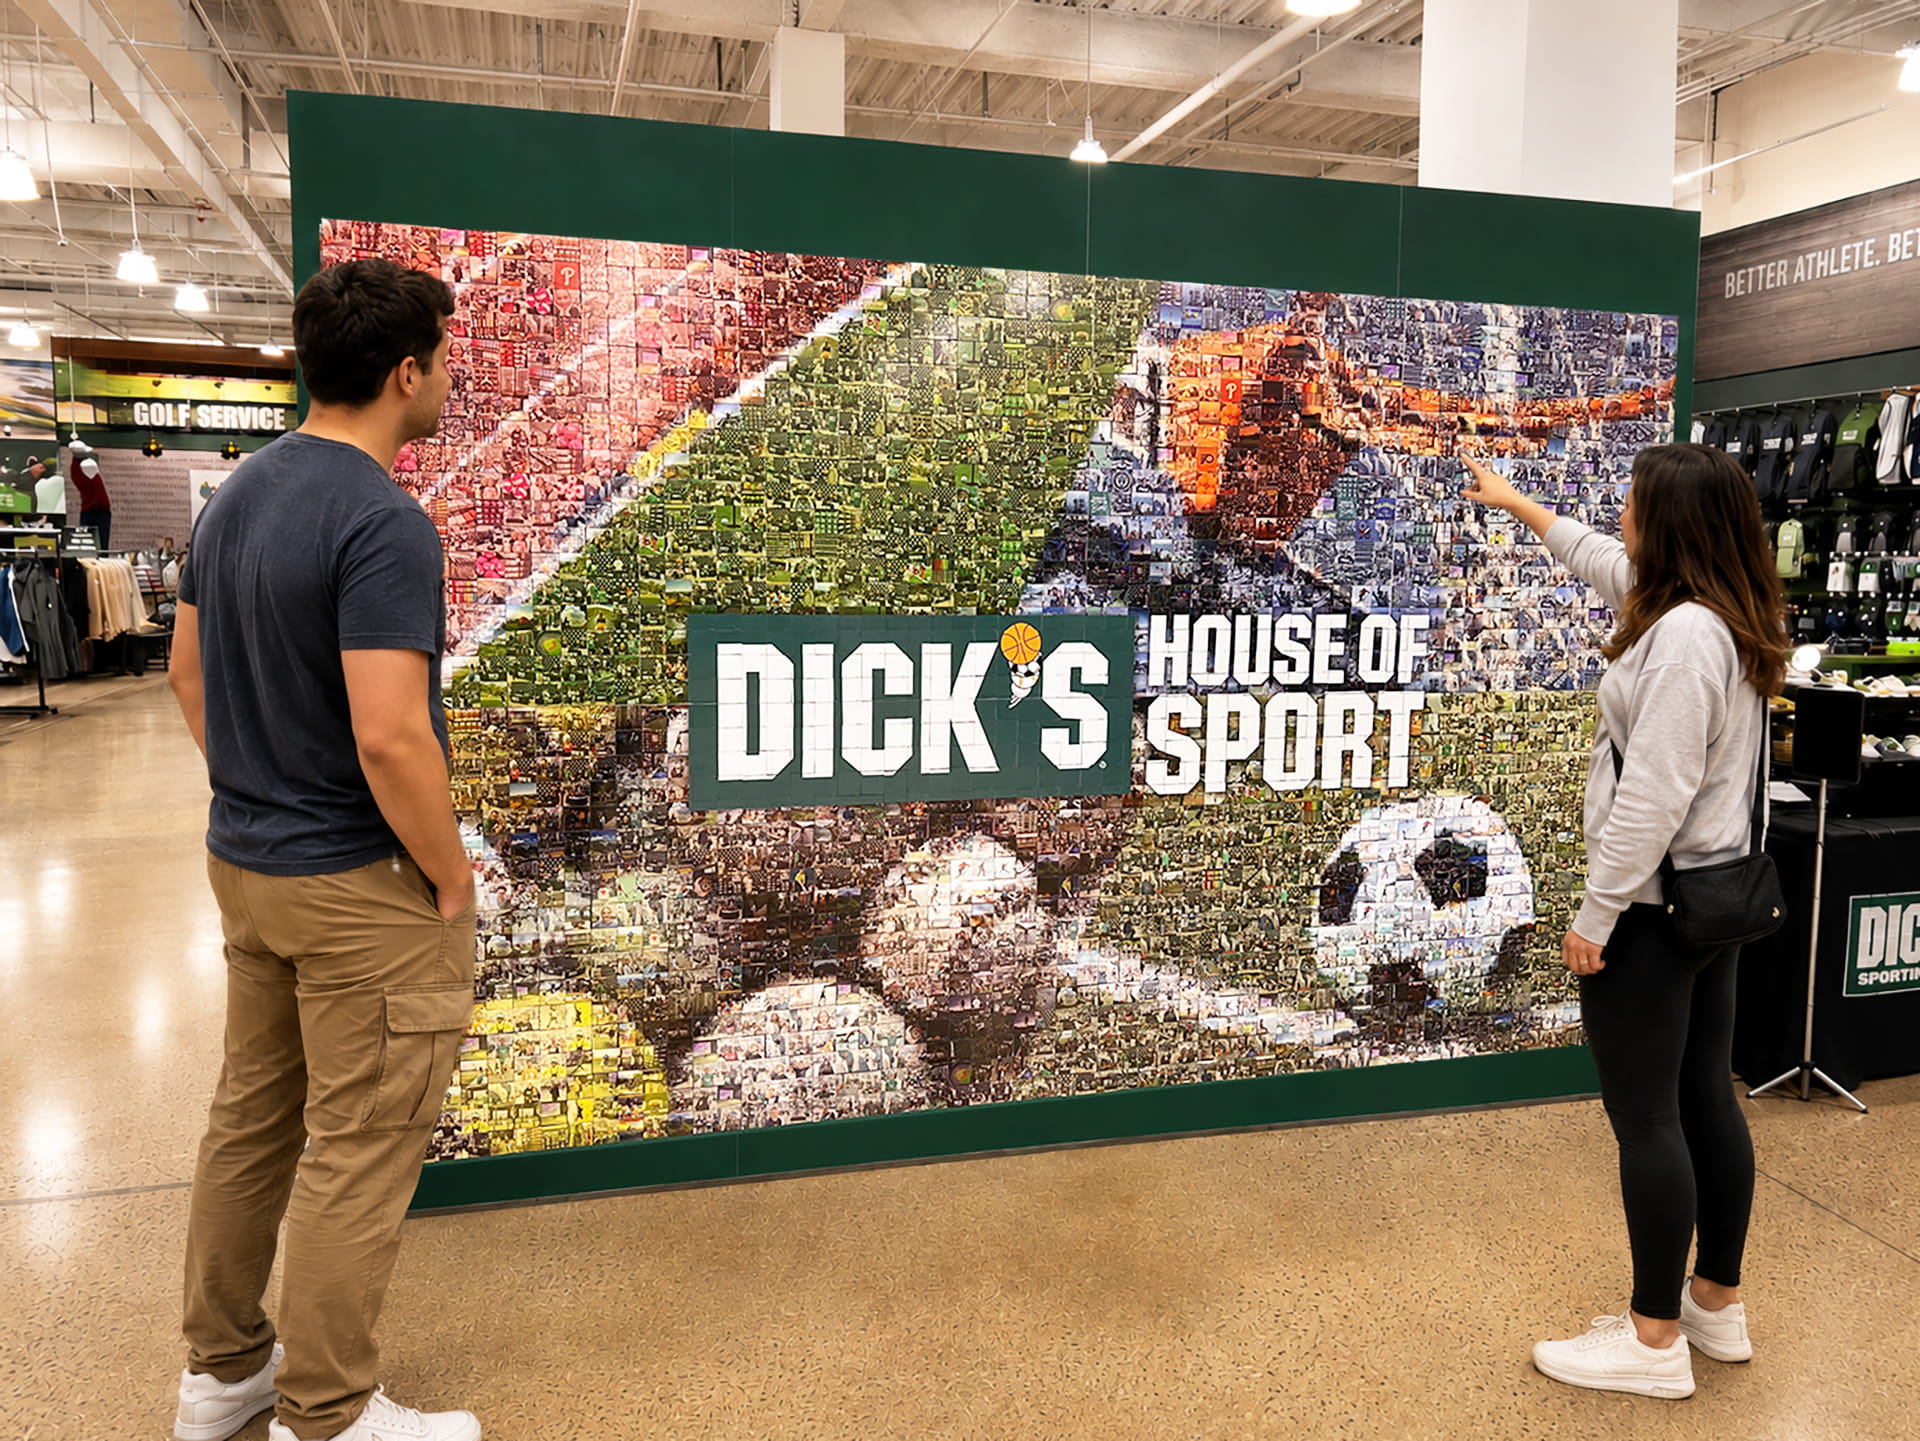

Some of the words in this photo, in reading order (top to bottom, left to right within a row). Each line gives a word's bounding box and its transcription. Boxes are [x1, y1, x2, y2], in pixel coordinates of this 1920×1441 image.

[1724, 259, 1788, 299] BETTER
[1793, 238, 1881, 285] ATHLETE.
[133, 401, 191, 428] GOLF
[196, 404, 286, 431] SERVICE
[1148, 613, 1348, 687] HOUSE
[1357, 613, 1430, 685] OF
[717, 622, 1109, 782] DICK'S
[1145, 690, 1425, 796] SPORT
